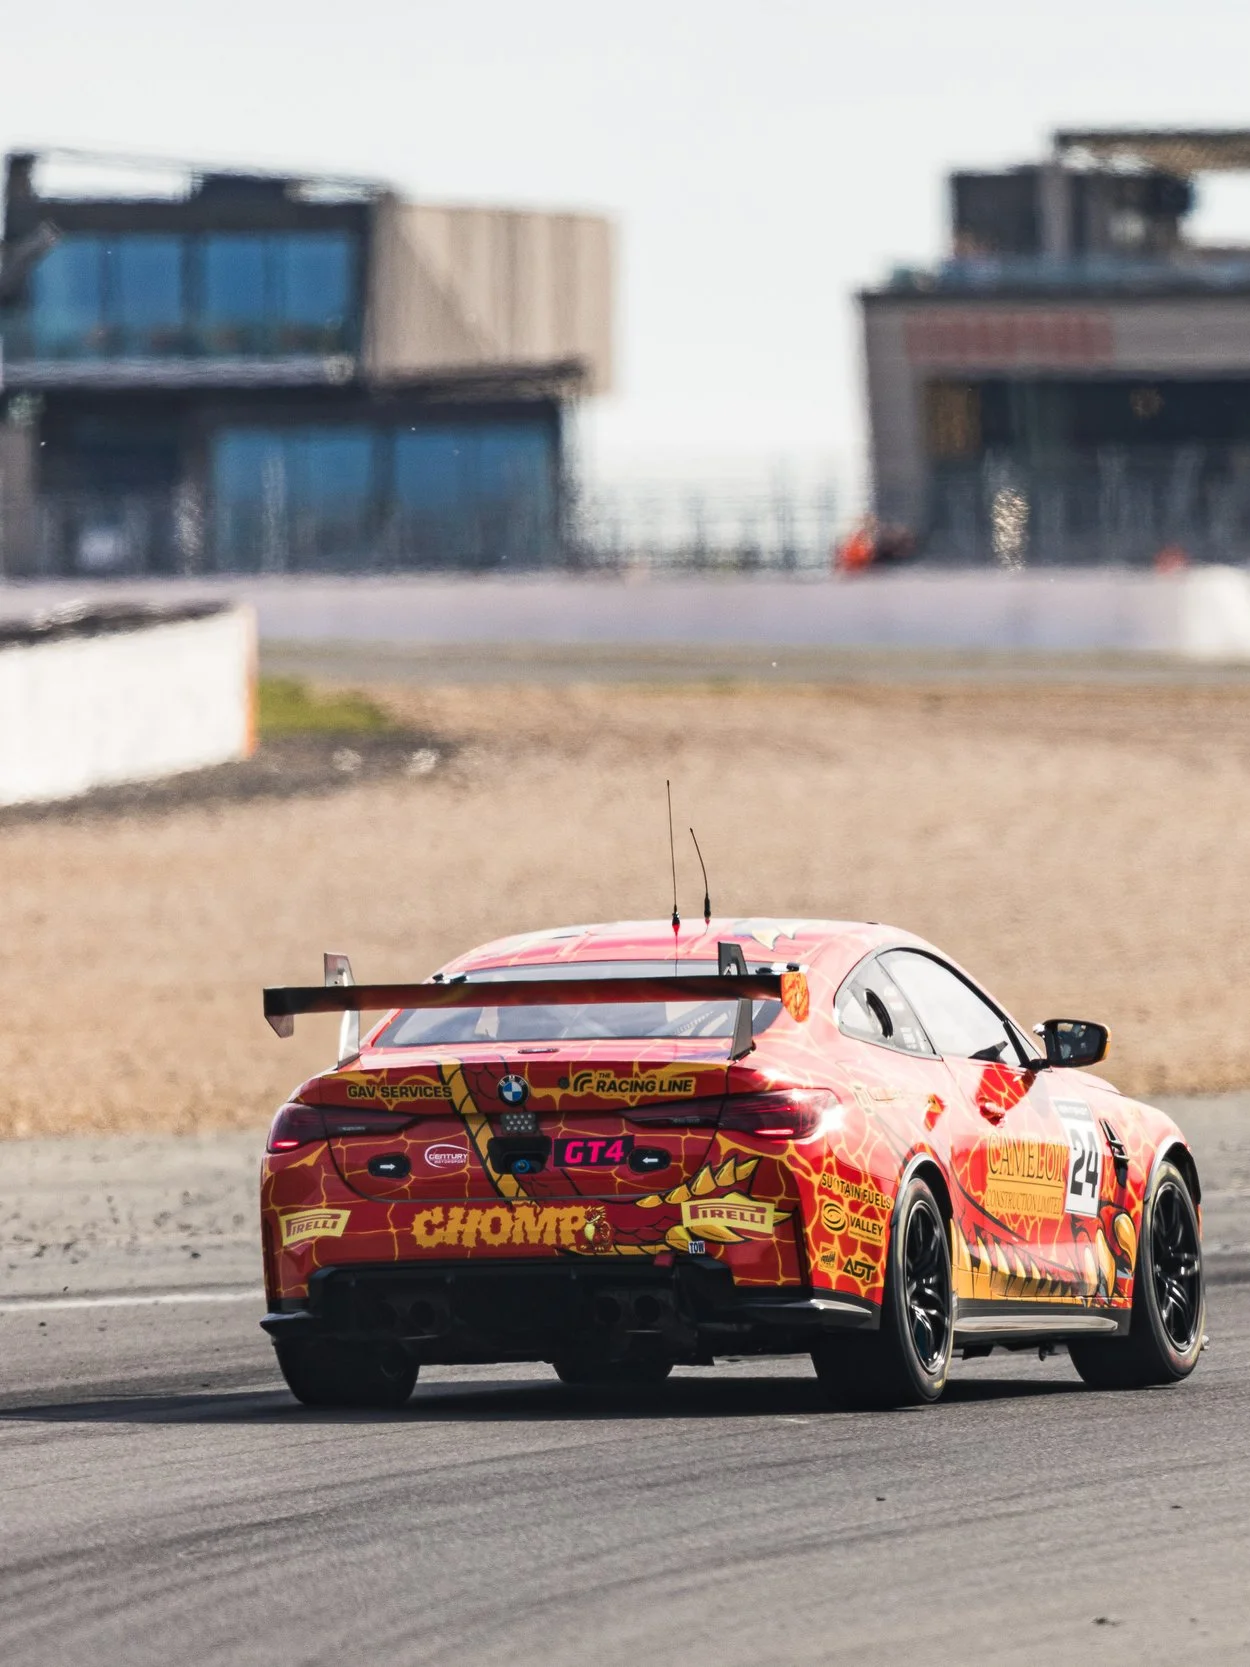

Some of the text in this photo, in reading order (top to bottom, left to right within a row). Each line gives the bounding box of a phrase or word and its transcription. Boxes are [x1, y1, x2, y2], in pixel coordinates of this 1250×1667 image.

[348, 1085, 452, 1098] GAV SERVICES
[596, 1079, 693, 1093] RACING LINE
[564, 1140, 625, 1164] GT4
[988, 1134, 1066, 1182] CAMELOT
[1070, 1128, 1098, 1198] 24
[863, 1189, 891, 1210] FUELS
[689, 1203, 767, 1224] PIRELLI
[286, 1213, 341, 1238] PIRELLI
[411, 1205, 587, 1248] CHOMP
[850, 1215, 883, 1237] VALLEY
[689, 1241, 705, 1253] TOW
